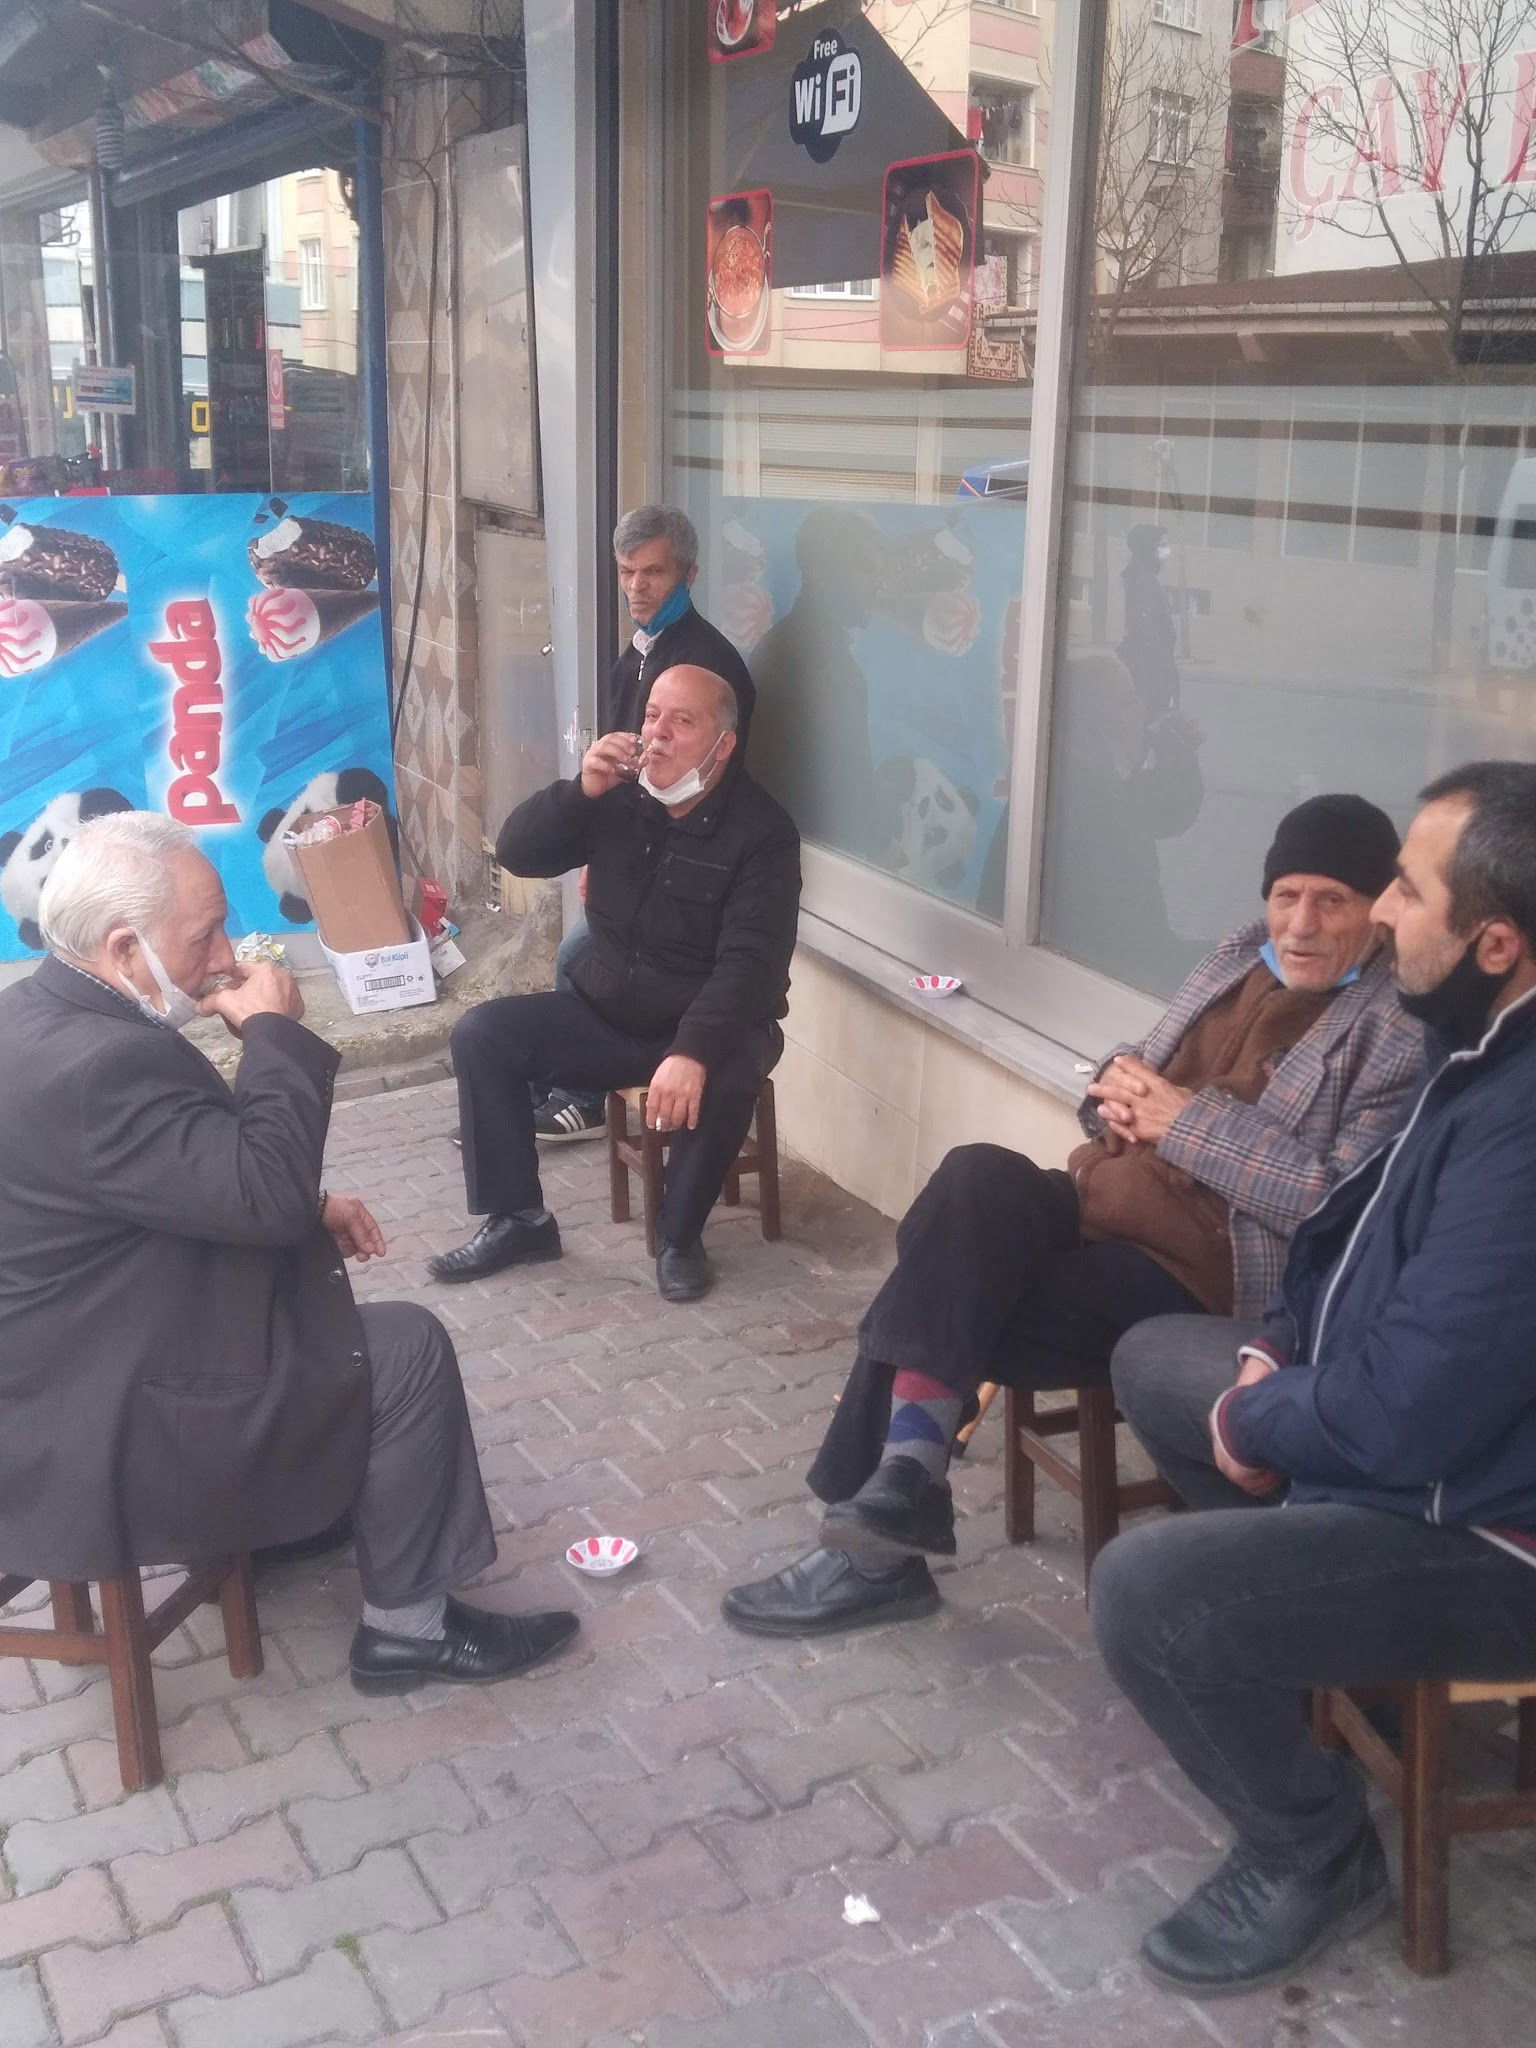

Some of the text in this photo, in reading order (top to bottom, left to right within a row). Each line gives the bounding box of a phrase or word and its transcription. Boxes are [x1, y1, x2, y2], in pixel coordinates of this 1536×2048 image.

[814, 39, 838, 60] Free
[1289, 62, 1480, 242] ÇAY
[147, 598, 242, 826] panda
